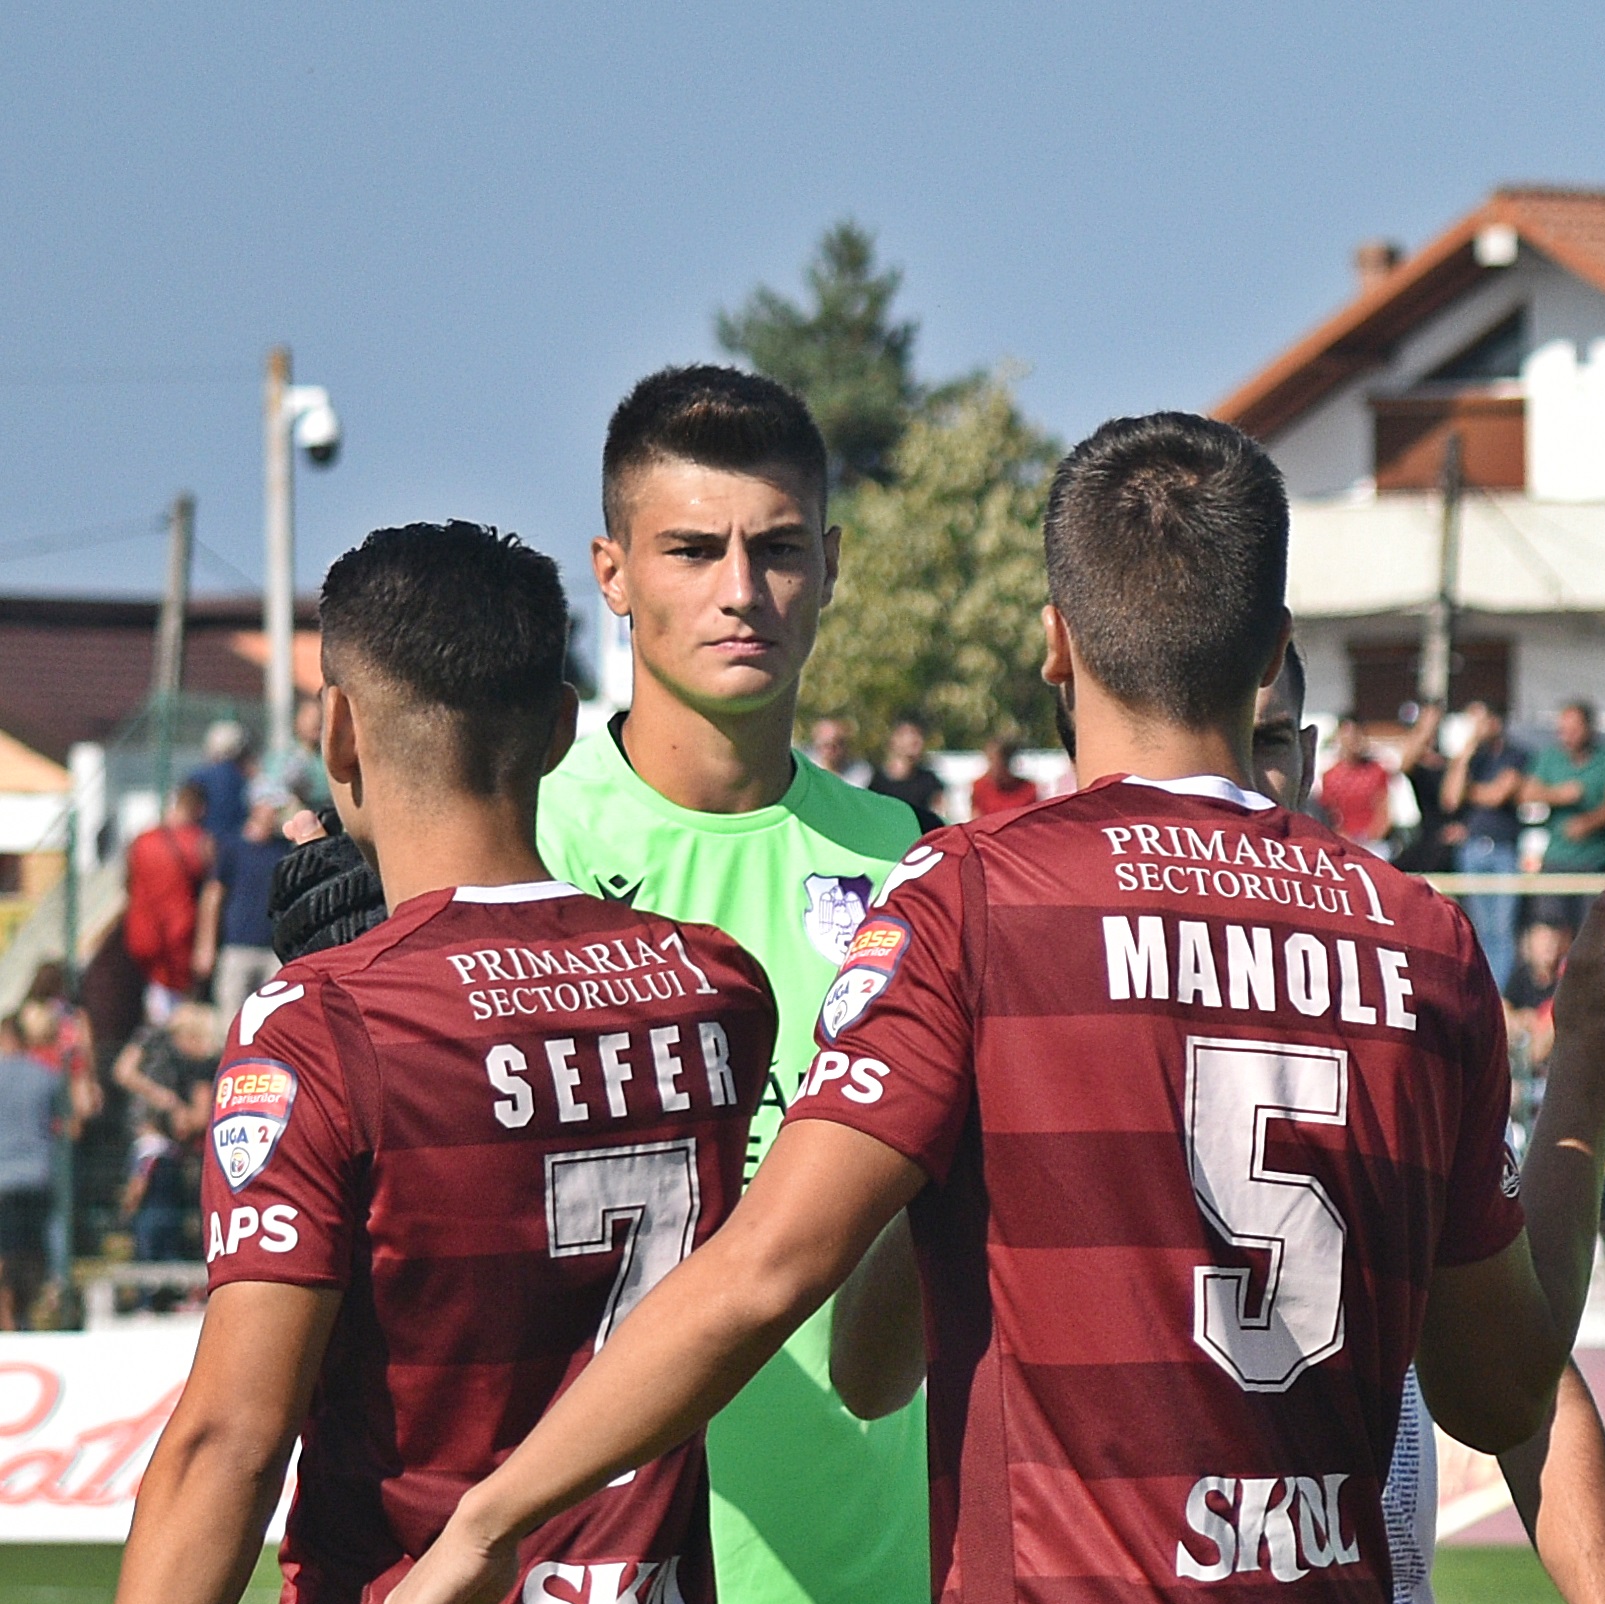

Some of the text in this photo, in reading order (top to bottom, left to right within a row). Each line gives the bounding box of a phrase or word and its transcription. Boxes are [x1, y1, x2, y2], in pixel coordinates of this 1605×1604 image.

[1102, 824, 1345, 882] PRIMARIA
[1115, 862, 1395, 926] SECTORULUI 1
[447, 937, 667, 984] PRIMARIA
[469, 932, 718, 1020] SECTORULUI 1
[860, 979, 874, 994] 2
[1102, 915, 1417, 1031] MANOLE
[231, 1093, 282, 1107] pariurilor
[234, 1074, 287, 1094] casa
[485, 1021, 738, 1129] SEFER
[219, 1125, 269, 1147] LIGA 2
[207, 1204, 299, 1264] APS
[1184, 1035, 1349, 1393] 5
[544, 1136, 701, 1487] 7
